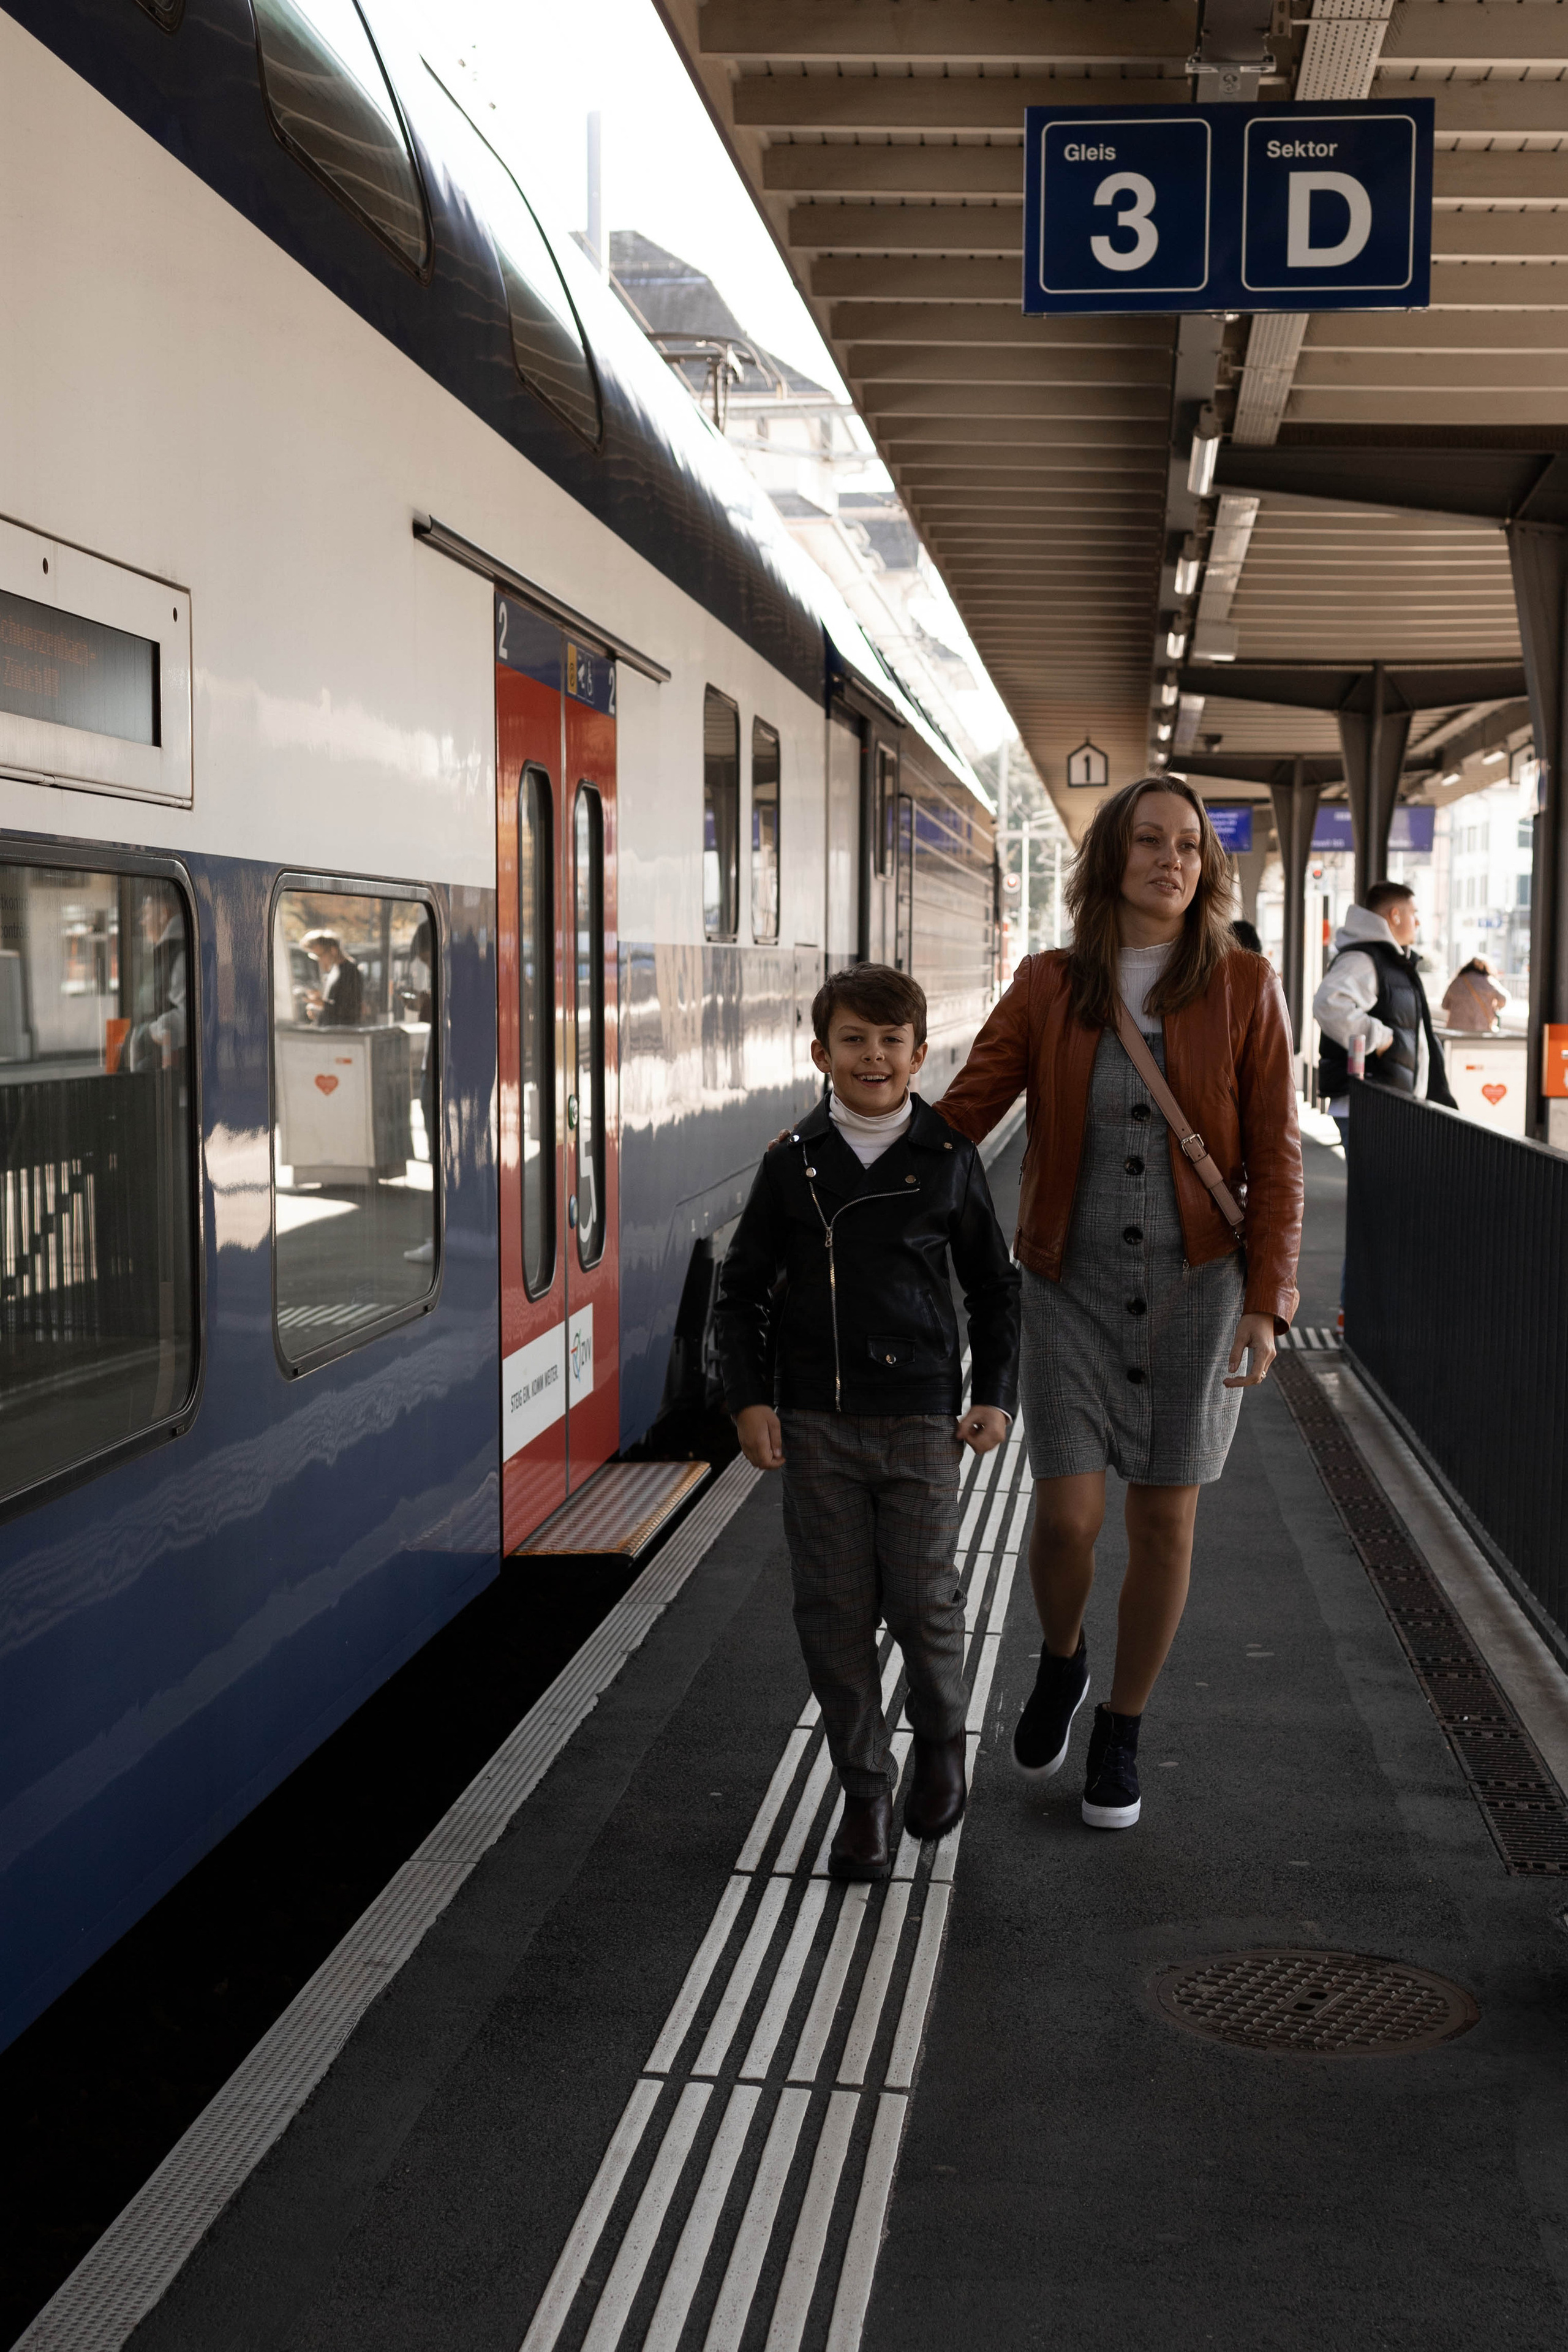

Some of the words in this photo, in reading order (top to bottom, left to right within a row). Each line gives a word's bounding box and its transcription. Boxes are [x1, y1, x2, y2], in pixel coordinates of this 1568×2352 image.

[1064, 143, 1117, 161] Gleis
[1267, 140, 1338, 159] Sektor
[1090, 172, 1159, 271] 3
[1287, 172, 1373, 268] D
[499, 602, 508, 659] 2
[609, 668, 615, 714] 2
[1084, 755, 1090, 781] 1
[581, 1336, 591, 1365] ZVV
[511, 1390, 522, 1413] STEIG
[532, 1374, 543, 1398] KOMM
